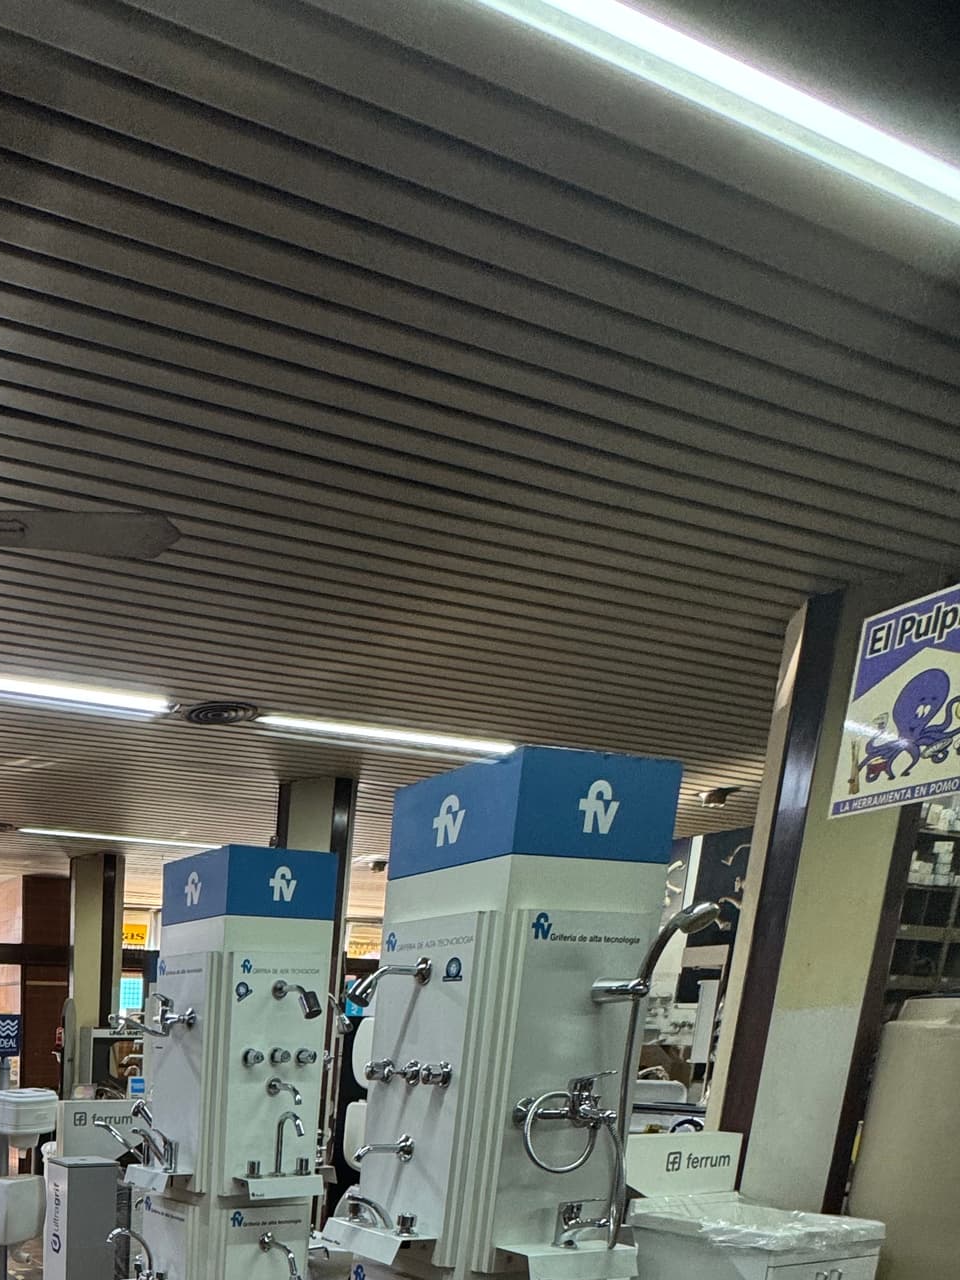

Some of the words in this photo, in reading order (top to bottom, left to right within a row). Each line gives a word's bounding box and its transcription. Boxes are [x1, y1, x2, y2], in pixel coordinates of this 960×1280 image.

[867, 621, 894, 657] El
[896, 603, 960, 647] Pulp
[579, 779, 620, 835] fv
[839, 802, 850, 812] LA
[851, 790, 912, 810] HERRAMIENTA
[914, 786, 928, 798] EN
[929, 779, 960, 794] POMO
[432, 794, 466, 848] fv
[184, 871, 202, 907] fv
[269, 865, 298, 902] fv
[531, 912, 552, 939] fv
[578, 934, 588, 942] de
[589, 934, 602, 943] alta
[92, 1112, 133, 1125] ferrum
[686, 1152, 731, 1169] ferrum
[52, 1182, 61, 1231] ultragrif
